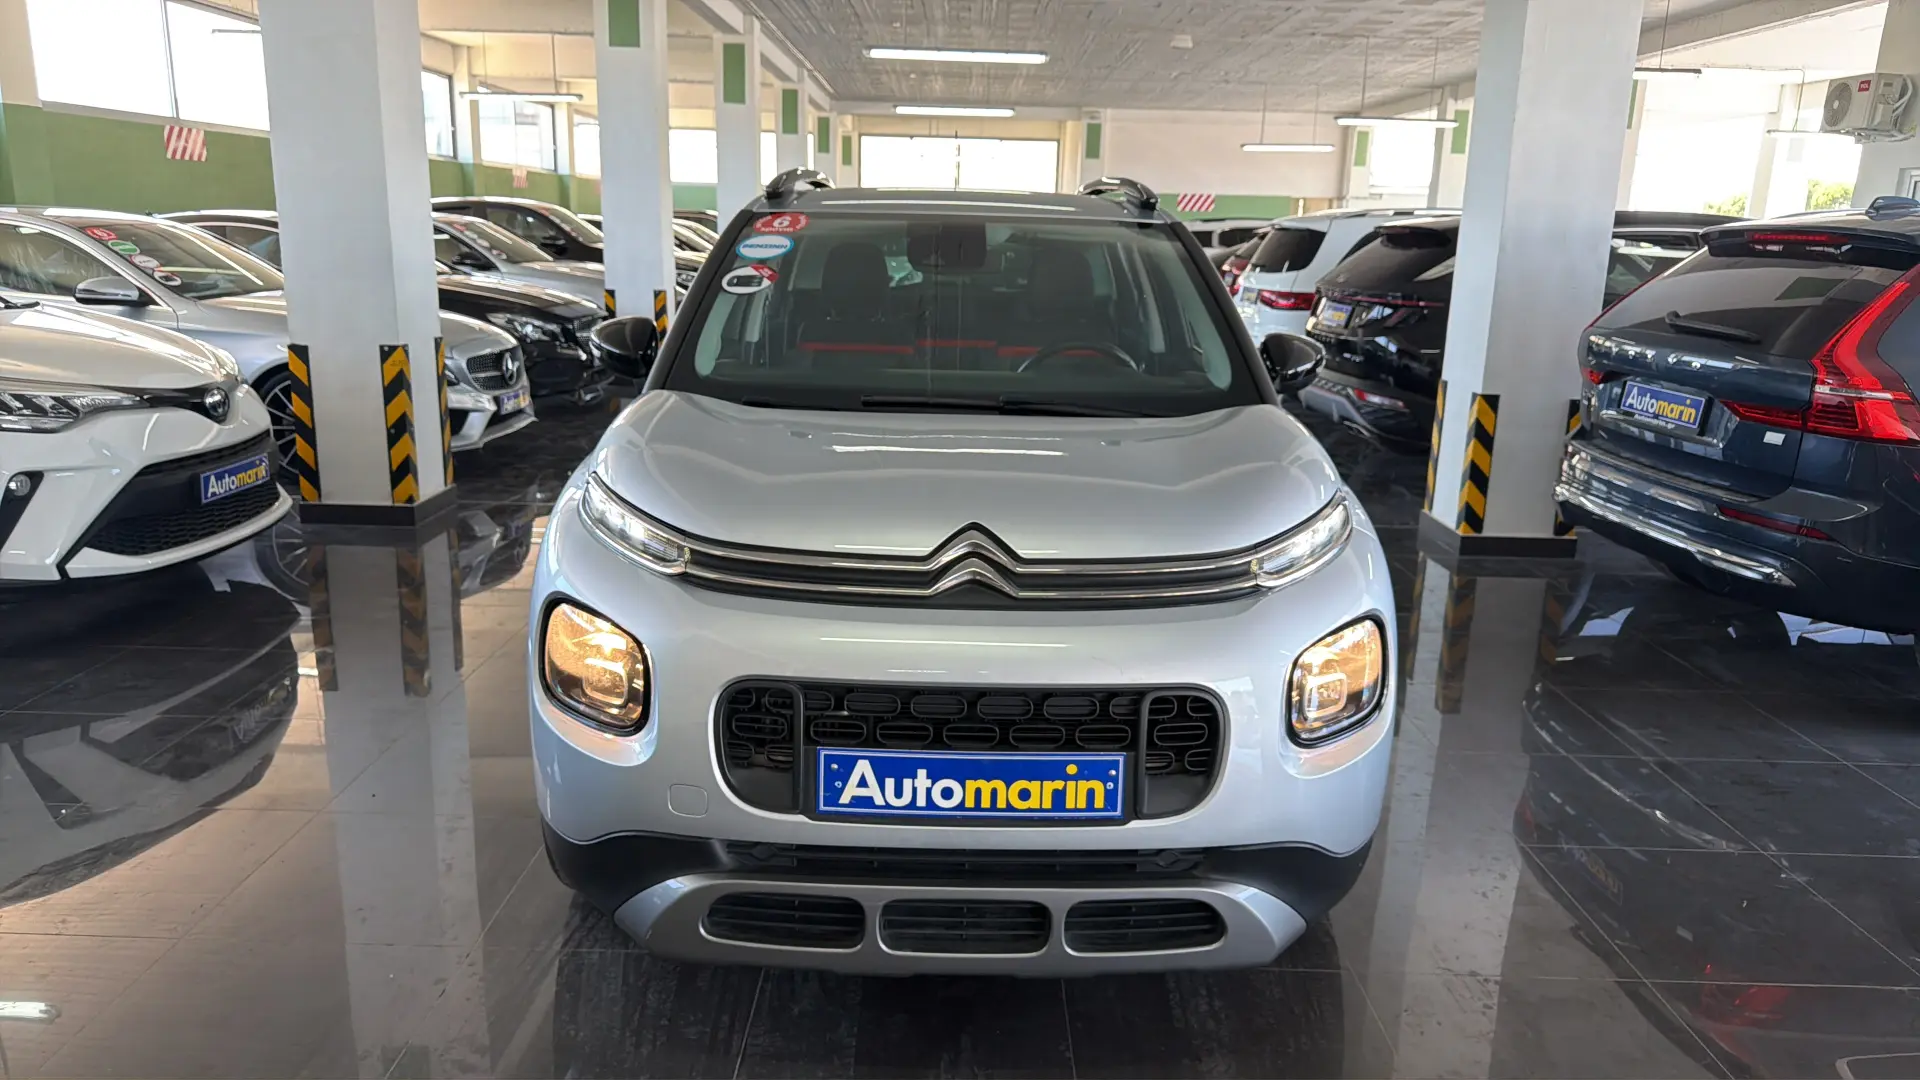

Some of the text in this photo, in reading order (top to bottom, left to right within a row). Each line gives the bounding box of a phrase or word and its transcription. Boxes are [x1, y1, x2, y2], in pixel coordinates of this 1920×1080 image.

[773, 215, 792, 228] 6
[1625, 386, 1697, 424] Automarin
[838, 759, 1105, 810] Automarin
